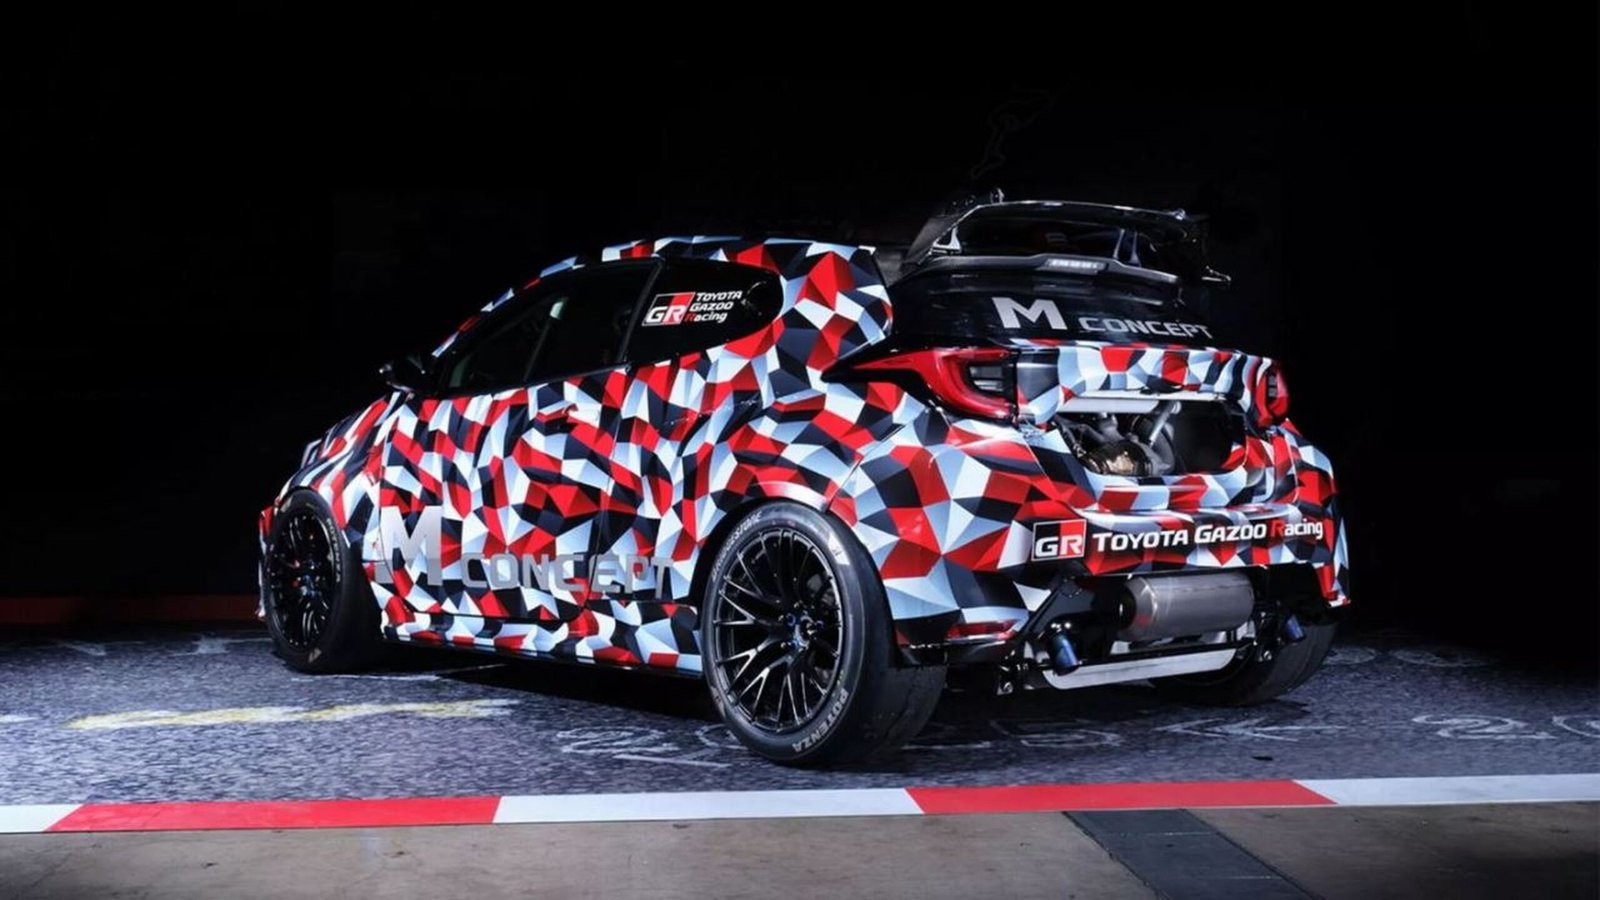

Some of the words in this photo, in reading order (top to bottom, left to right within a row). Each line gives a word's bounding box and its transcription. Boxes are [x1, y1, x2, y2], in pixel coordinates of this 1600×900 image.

[689, 301, 734, 312] GAZOO
[696, 290, 743, 302] TOYOTA
[645, 305, 686, 323] GR
[684, 311, 728, 323] Racing
[991, 297, 1068, 330] M
[1077, 316, 1214, 339] CONCEPT
[1035, 534, 1083, 557] GR
[1092, 528, 1188, 552] TOYOTA
[1194, 522, 1267, 544] GAZOO
[1270, 518, 1324, 540] Racing
[374, 505, 443, 586] M
[461, 552, 675, 599] CONCEPT
[792, 687, 849, 752] POTENZA
